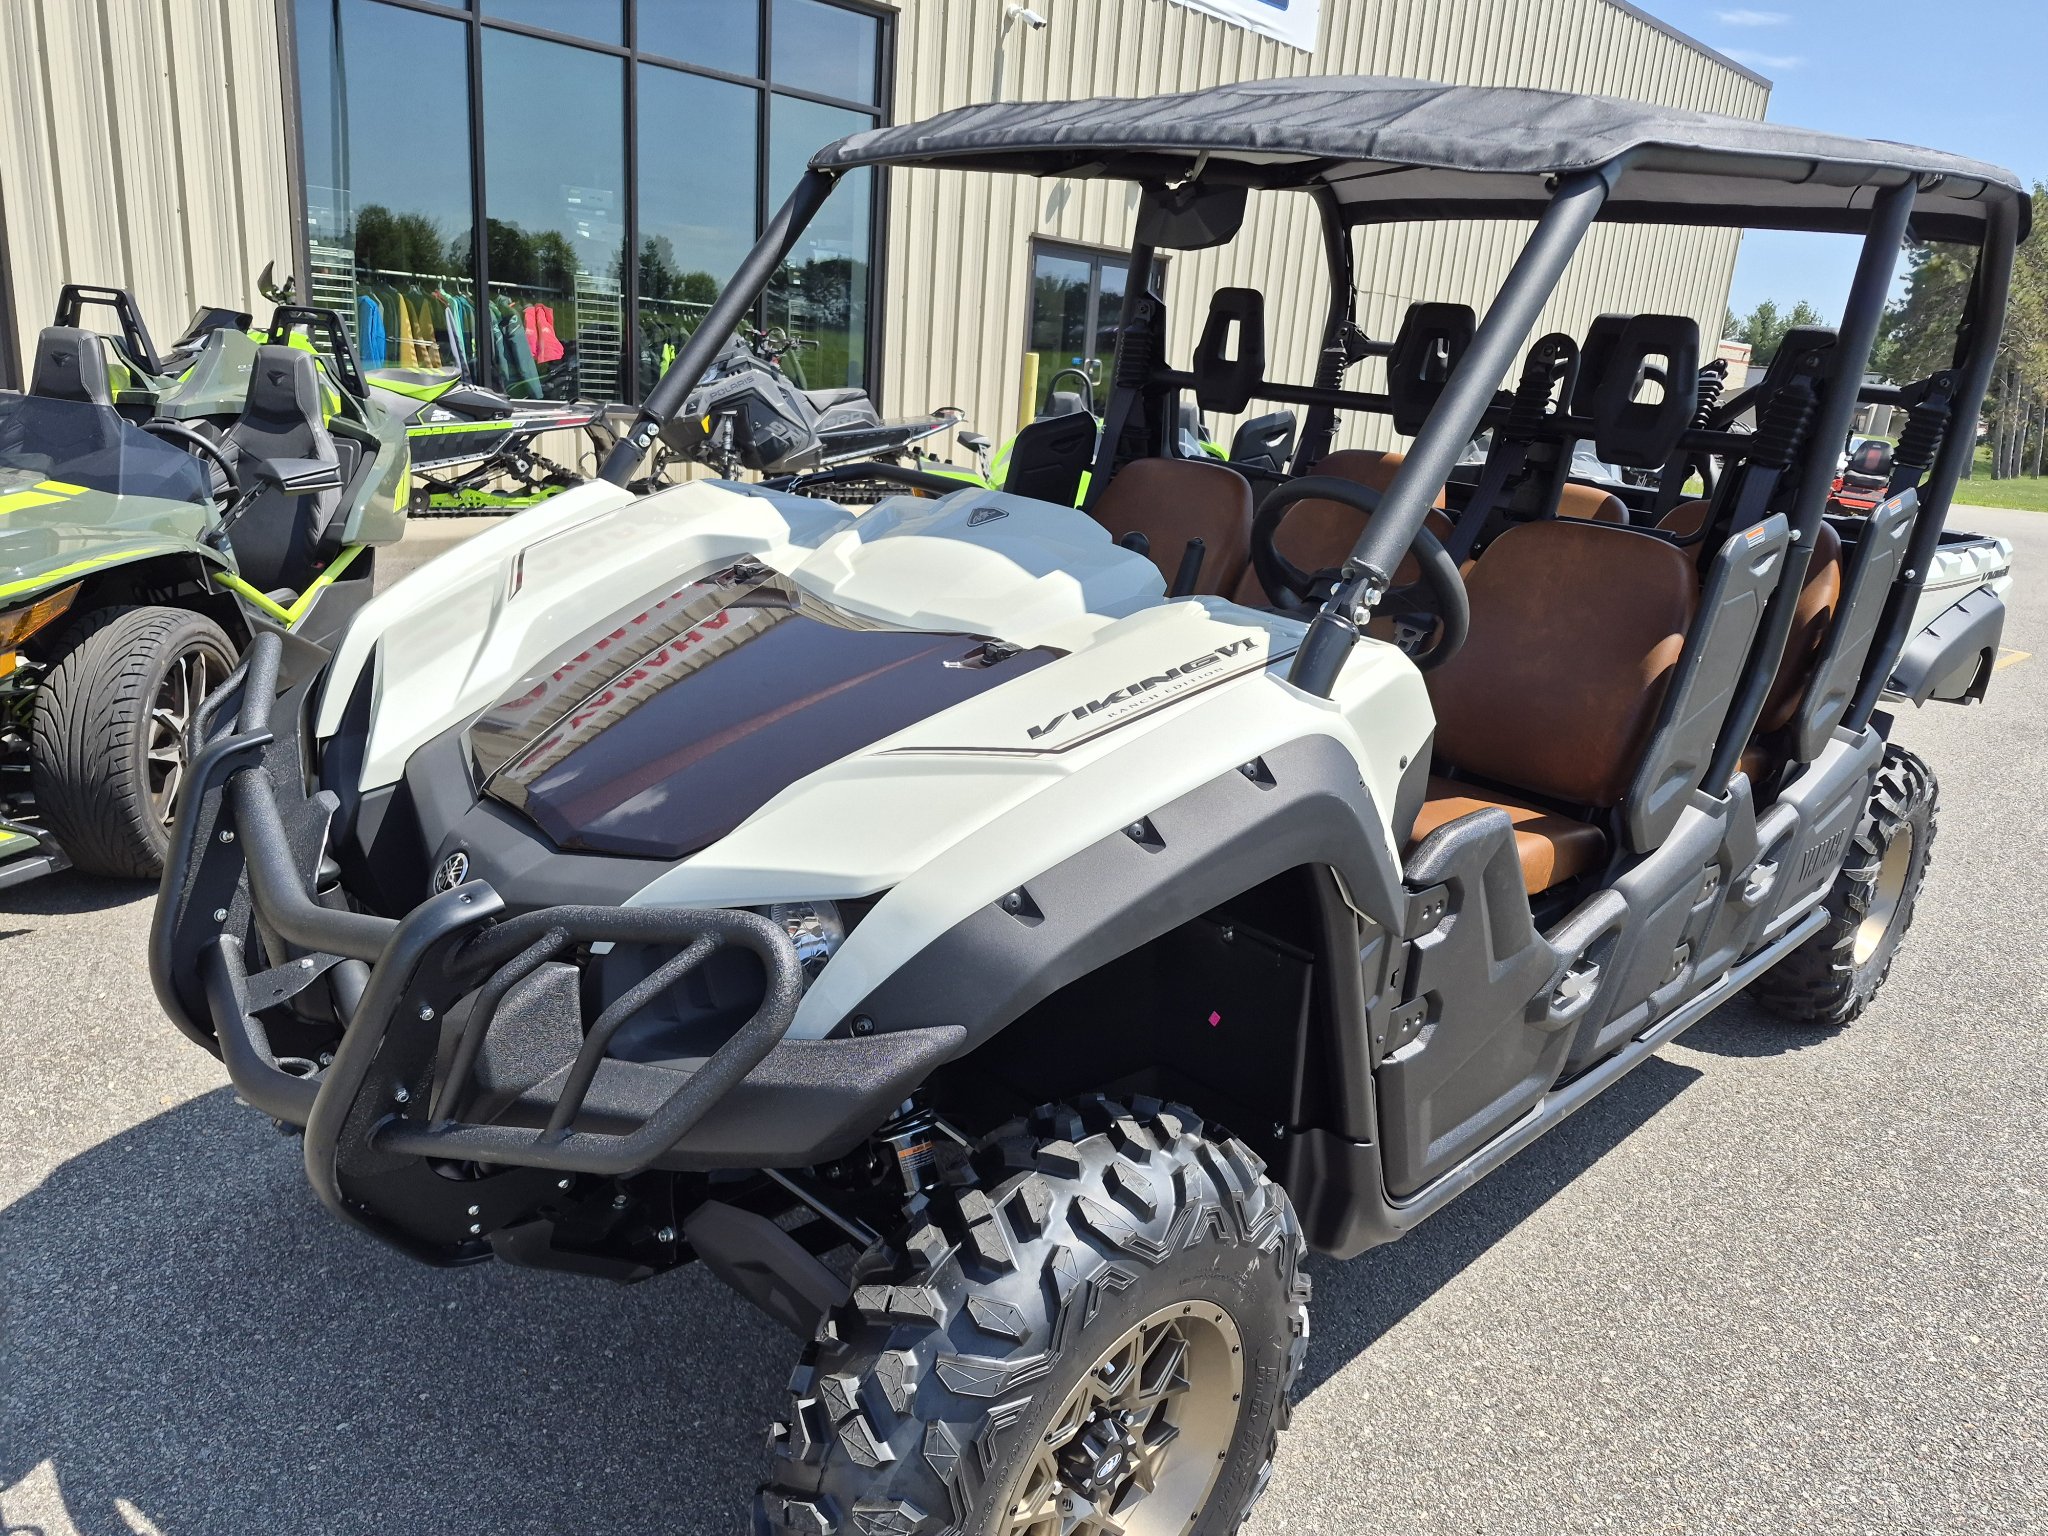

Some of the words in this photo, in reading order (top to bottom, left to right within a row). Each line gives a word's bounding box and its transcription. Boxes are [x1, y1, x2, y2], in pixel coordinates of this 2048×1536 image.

[710, 375, 755, 400] POLARIS
[1027, 653, 1222, 740] VIKING
[1107, 694, 1159, 718] RANCH
[1164, 667, 1224, 693] EDITION
